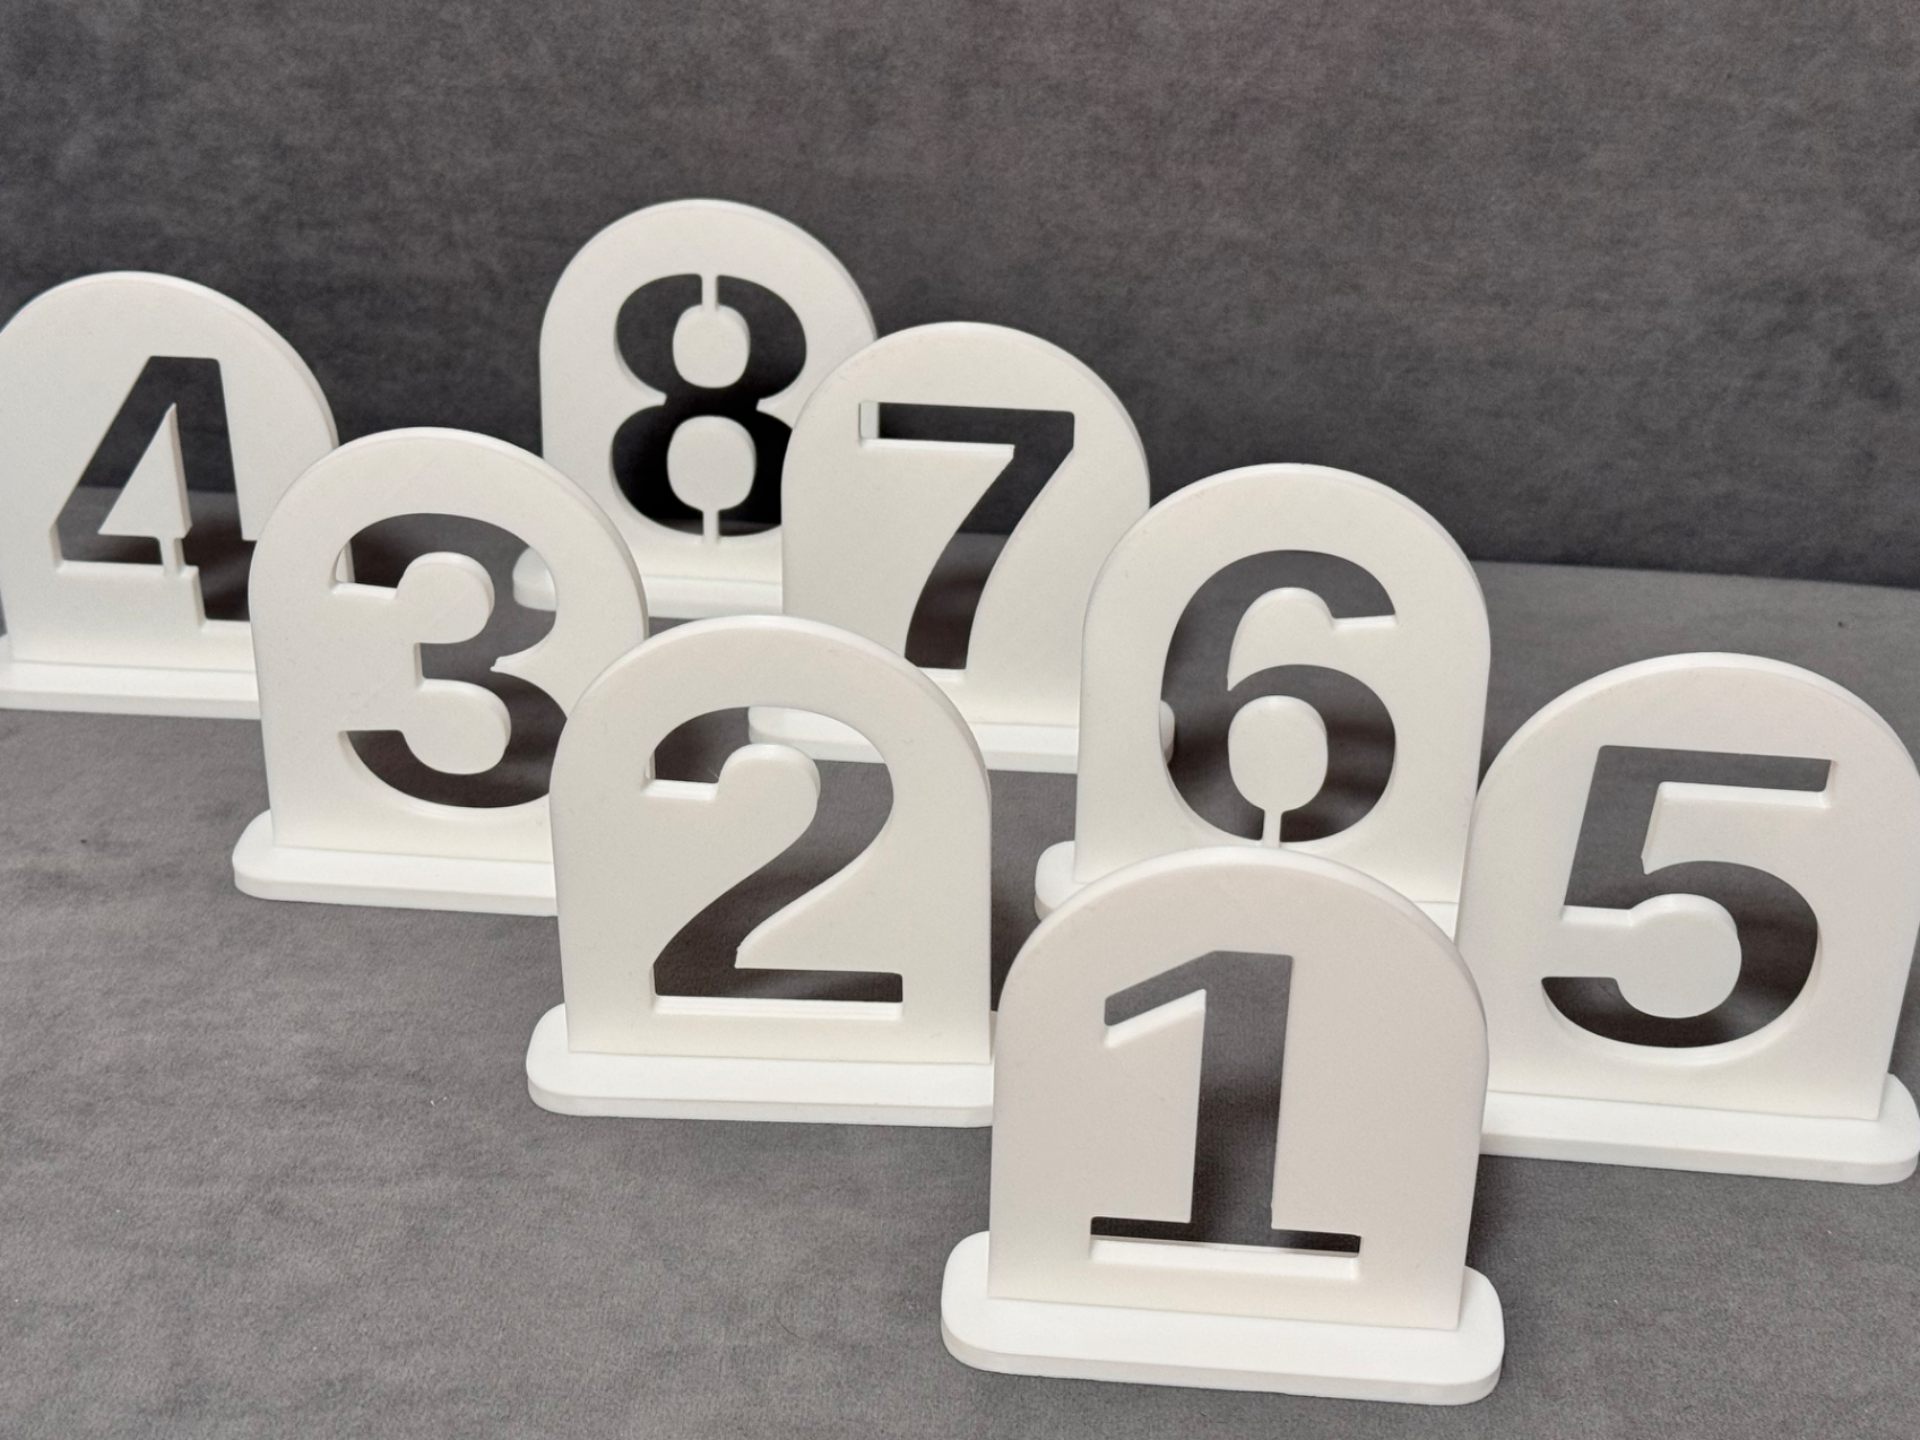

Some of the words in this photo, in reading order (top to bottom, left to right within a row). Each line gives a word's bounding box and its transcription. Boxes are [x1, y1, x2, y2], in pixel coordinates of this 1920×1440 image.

[48, 355, 257, 630] 4
[609, 273, 807, 538] 8
[859, 401, 1076, 681] 7
[332, 512, 567, 813] 3
[1159, 549, 1397, 847] 6
[642, 705, 904, 1017] 2
[1541, 744, 1837, 1058] 5
[1090, 949, 1362, 1280] 1
